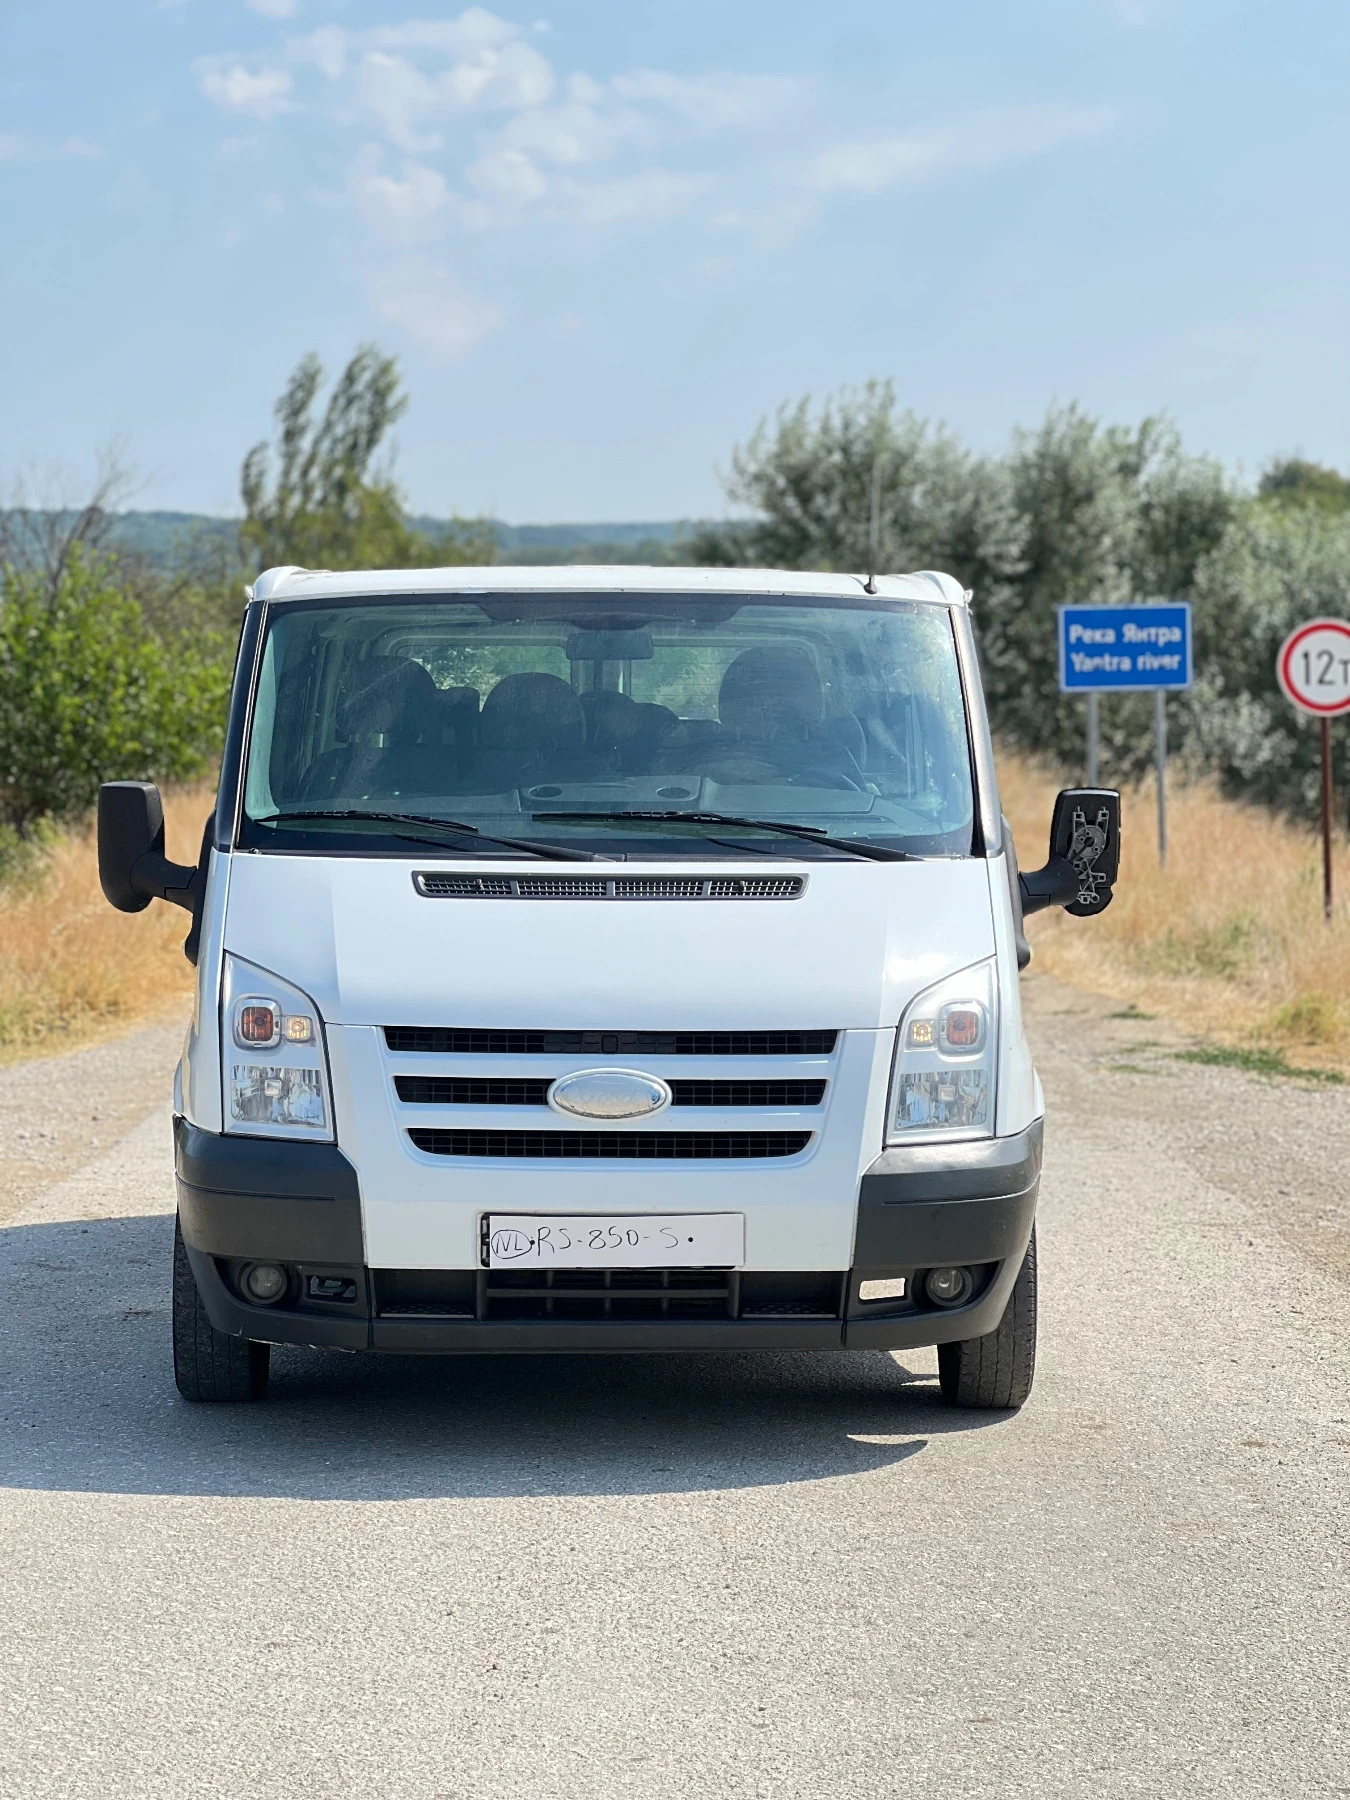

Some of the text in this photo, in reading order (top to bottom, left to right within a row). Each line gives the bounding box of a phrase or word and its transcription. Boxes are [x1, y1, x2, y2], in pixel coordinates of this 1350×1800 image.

[1069, 622, 1182, 648] Река Янтра
[1070, 651, 1181, 673] Yantra river
[496, 1232, 524, 1255] NL
